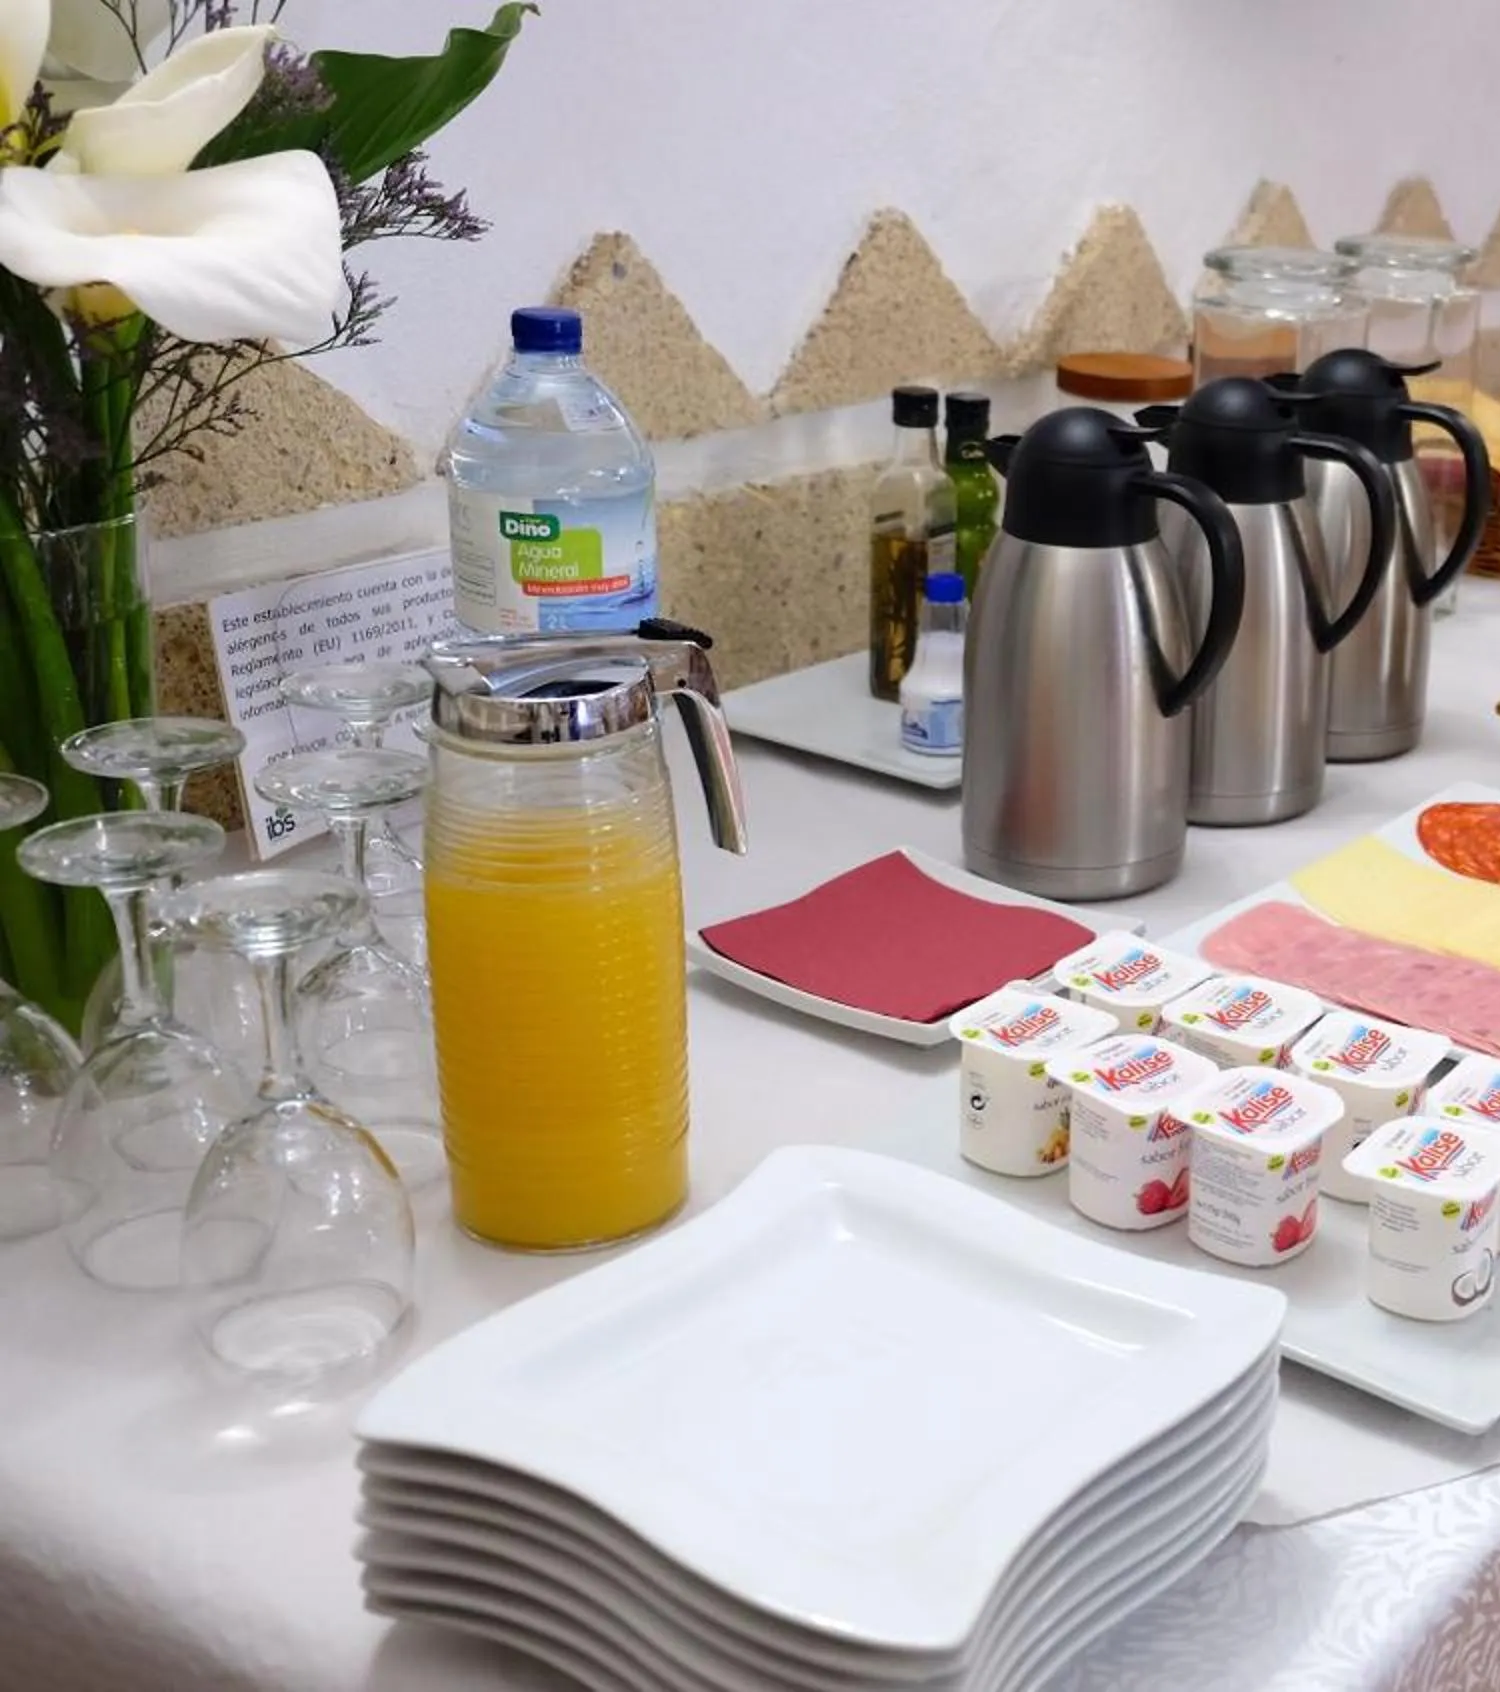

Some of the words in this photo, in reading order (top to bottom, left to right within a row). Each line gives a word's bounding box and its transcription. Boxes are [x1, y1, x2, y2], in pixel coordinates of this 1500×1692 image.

[505, 519, 551, 537] Dino
[517, 543, 562, 563] Agua
[519, 561, 579, 577] Mineral
[222, 615, 249, 633] Este
[357, 579, 397, 599] cuenta
[401, 573, 423, 589] con
[299, 621, 316, 636] de
[326, 611, 361, 629] todos
[371, 601, 391, 617] sus
[231, 646, 303, 677] Reglamento
[313, 636, 342, 656] (EU)
[265, 812, 296, 841] ibs
[1092, 952, 1162, 991] Kalise
[988, 1005, 1059, 1047] Kalise
[1204, 989, 1268, 1031] Kalise
[1093, 1049, 1173, 1092] Kalise
[1328, 1028, 1386, 1074] Kalise
[1216, 1085, 1291, 1133] Kalise
[1394, 1130, 1460, 1181] Kalise
